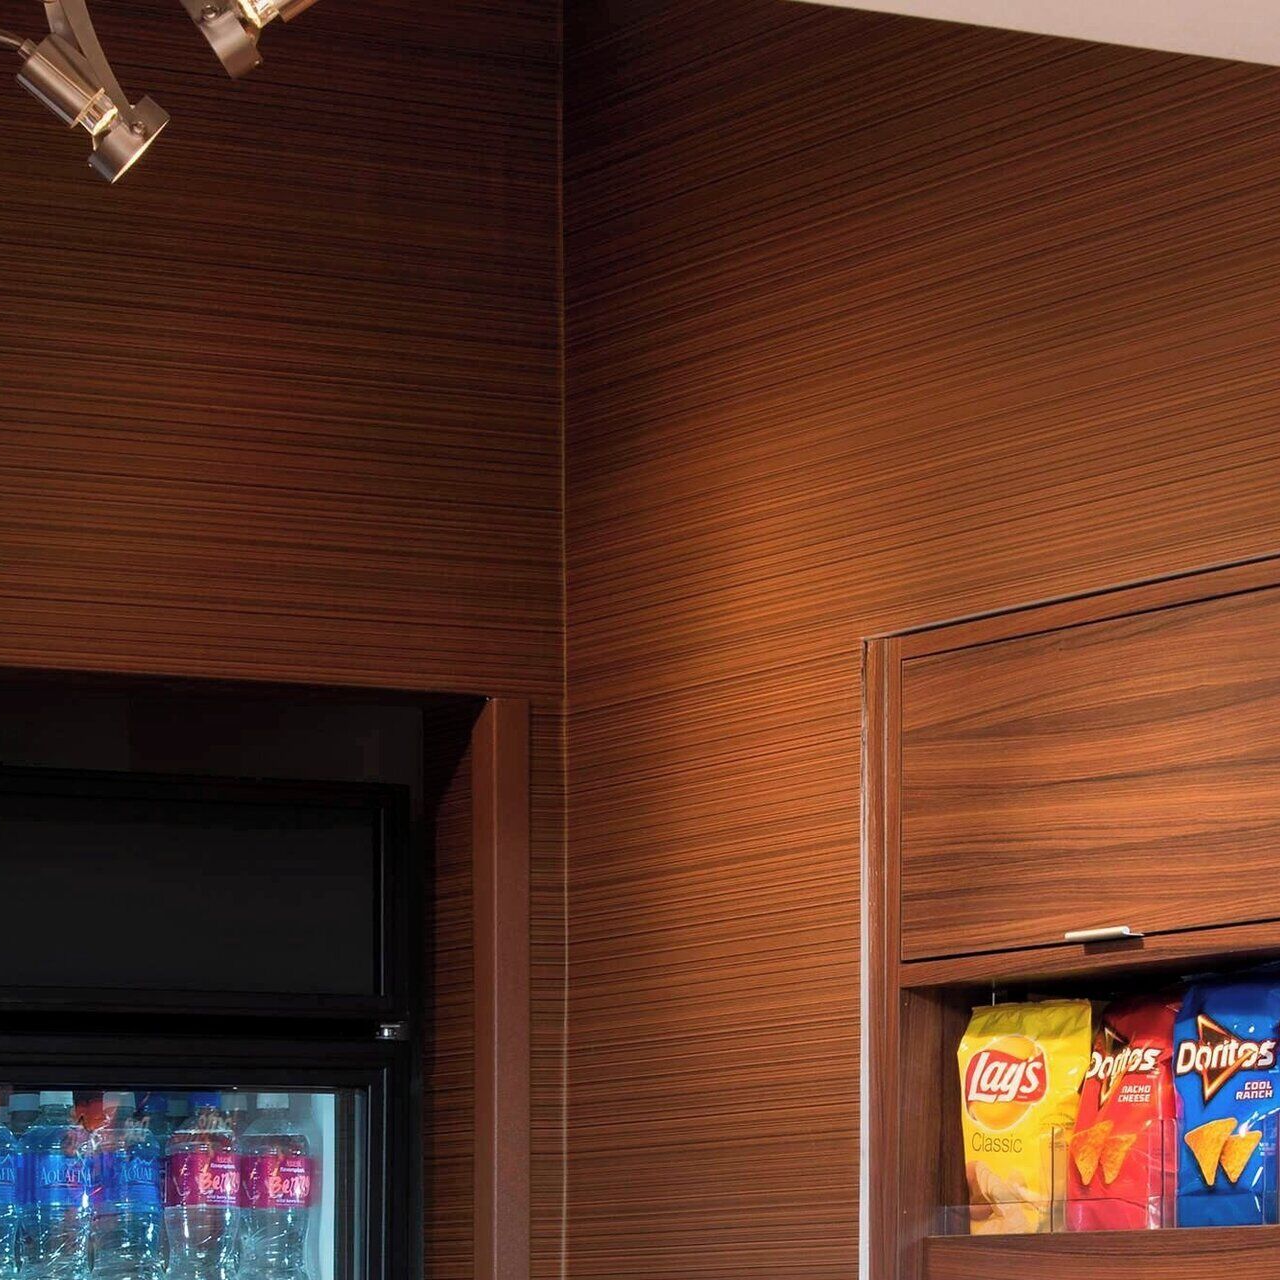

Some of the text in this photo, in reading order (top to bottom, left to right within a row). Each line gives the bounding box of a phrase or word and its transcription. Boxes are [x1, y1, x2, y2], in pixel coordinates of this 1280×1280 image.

[1086, 1047, 1162, 1080] Doritos
[1176, 1040, 1277, 1074] Doritos
[967, 1051, 1045, 1104] Lay's
[1121, 1085, 1151, 1093] NACHO
[1245, 1081, 1272, 1090] COOL
[1118, 1094, 1151, 1102] CHEESE
[1236, 1090, 1273, 1099] RANCH
[971, 1132, 1022, 1154] Classic
